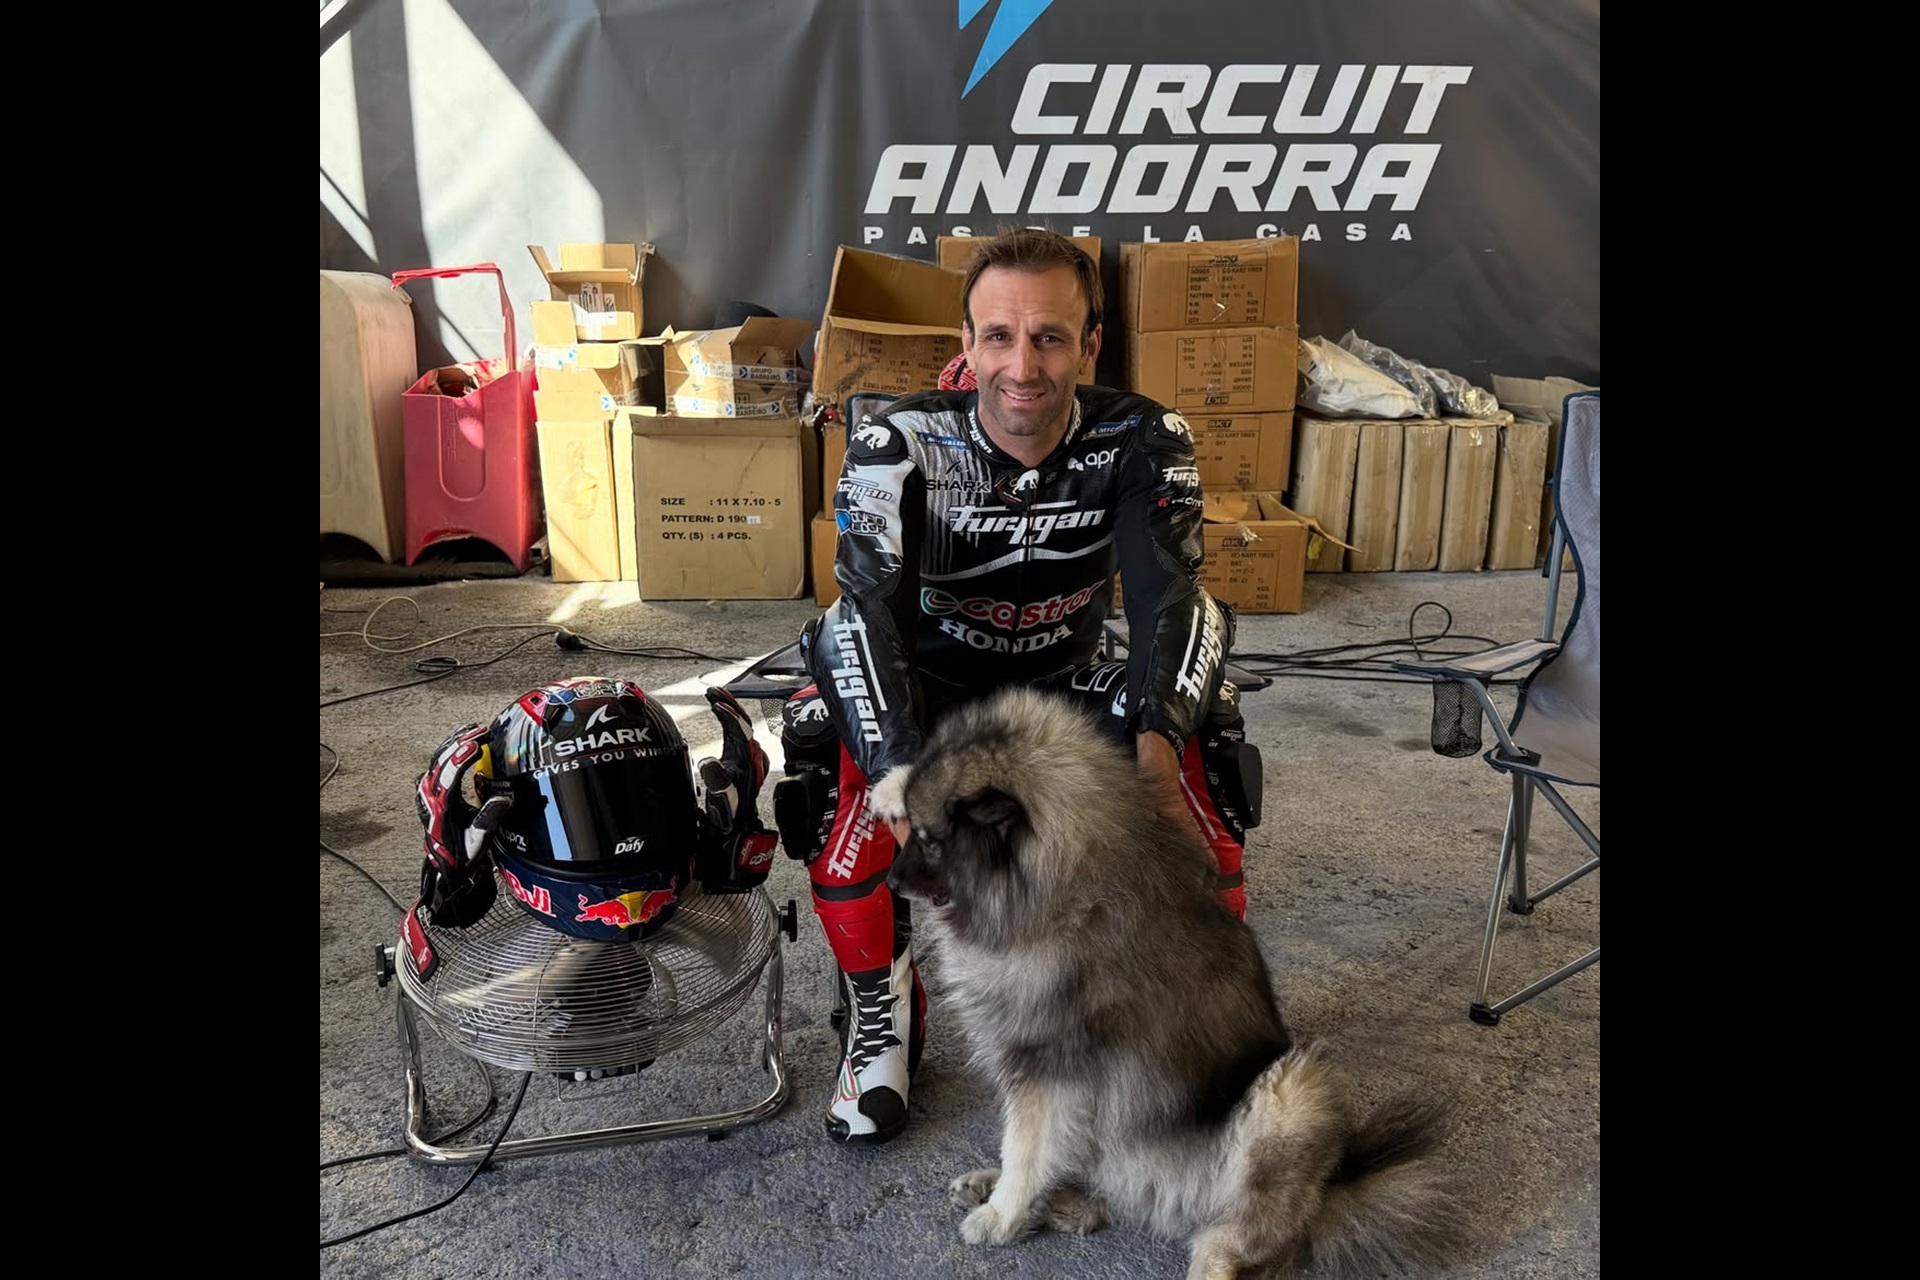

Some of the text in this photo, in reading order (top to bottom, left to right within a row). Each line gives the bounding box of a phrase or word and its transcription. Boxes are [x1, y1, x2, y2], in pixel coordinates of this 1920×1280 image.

[1011, 63, 1473, 135] CIRCUIT
[864, 143, 1442, 214] ANDORRA
[864, 223, 1412, 245] PAS E LA CASA
[926, 479, 991, 493] SHARK
[662, 515, 714, 523] PATTERN:
[717, 515, 724, 523] D
[729, 515, 747, 523] 190
[662, 532, 686, 540] QTY.
[690, 532, 704, 541] (S)
[717, 532, 724, 540] 4
[728, 532, 751, 540] PCS.
[938, 618, 1073, 654] HONDA
[555, 727, 652, 757] SHARK
[533, 760, 580, 780] GIVES
[590, 751, 625, 764] YOU
[614, 838, 645, 855] Dafy
